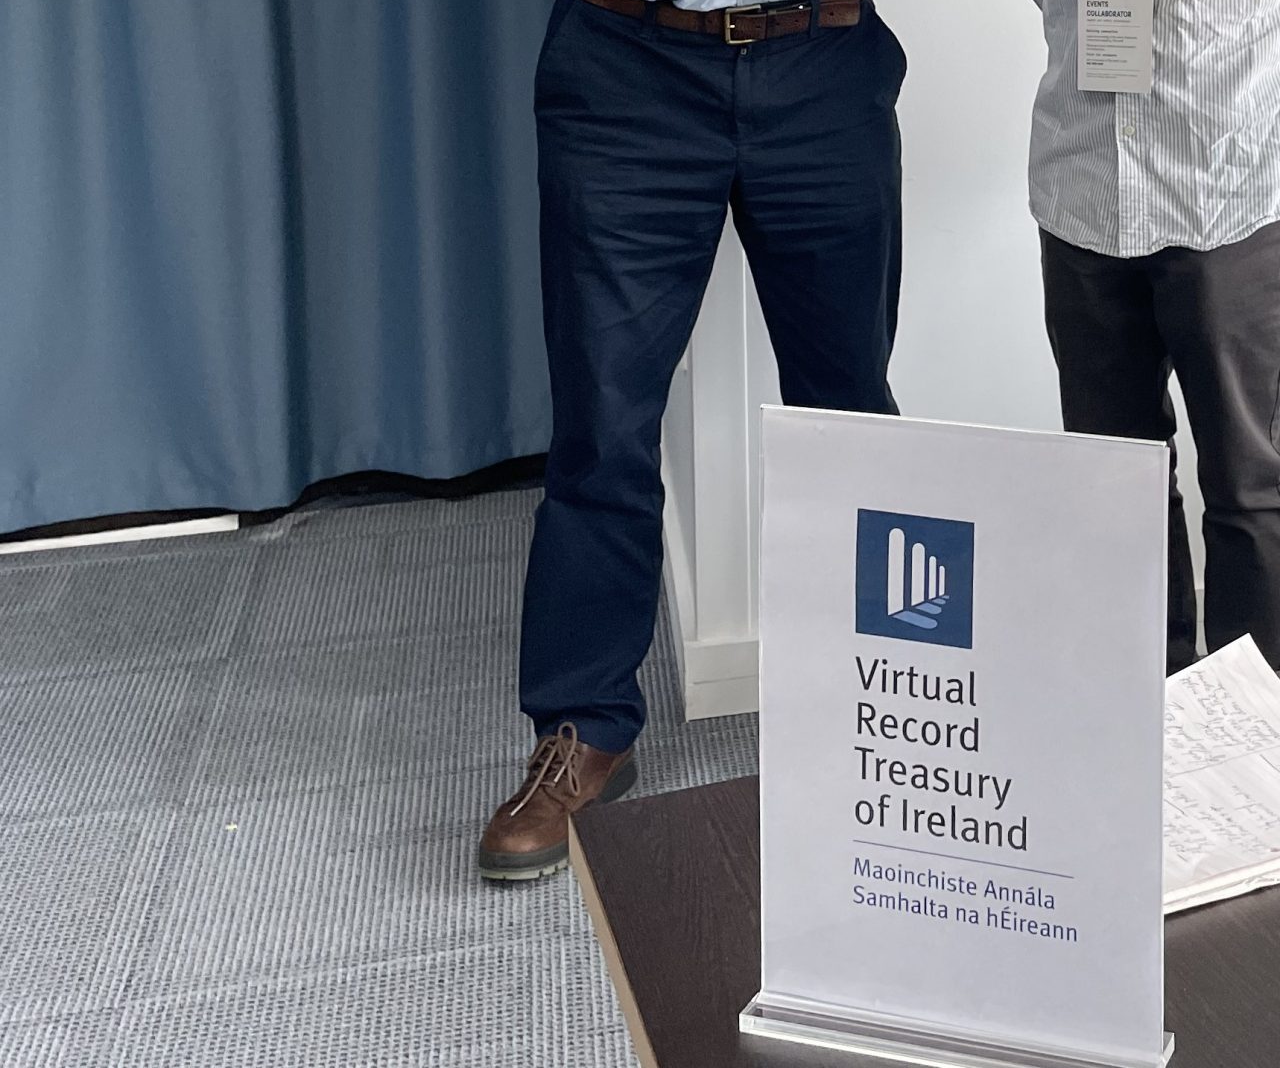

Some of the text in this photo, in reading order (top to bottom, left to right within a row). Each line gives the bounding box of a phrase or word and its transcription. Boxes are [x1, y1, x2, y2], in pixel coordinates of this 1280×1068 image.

[1086, 0, 1109, 8] EVENTS
[1086, 10, 1132, 18] COLLABORATOR
[855, 655, 977, 707] Virtual
[857, 702, 980, 753] Record
[854, 746, 1012, 811] Treasury
[854, 794, 1028, 851] of Ireland
[854, 857, 1055, 910] Maoinchiste Annála
[853, 885, 1078, 942] Samhalta na hÉireann
